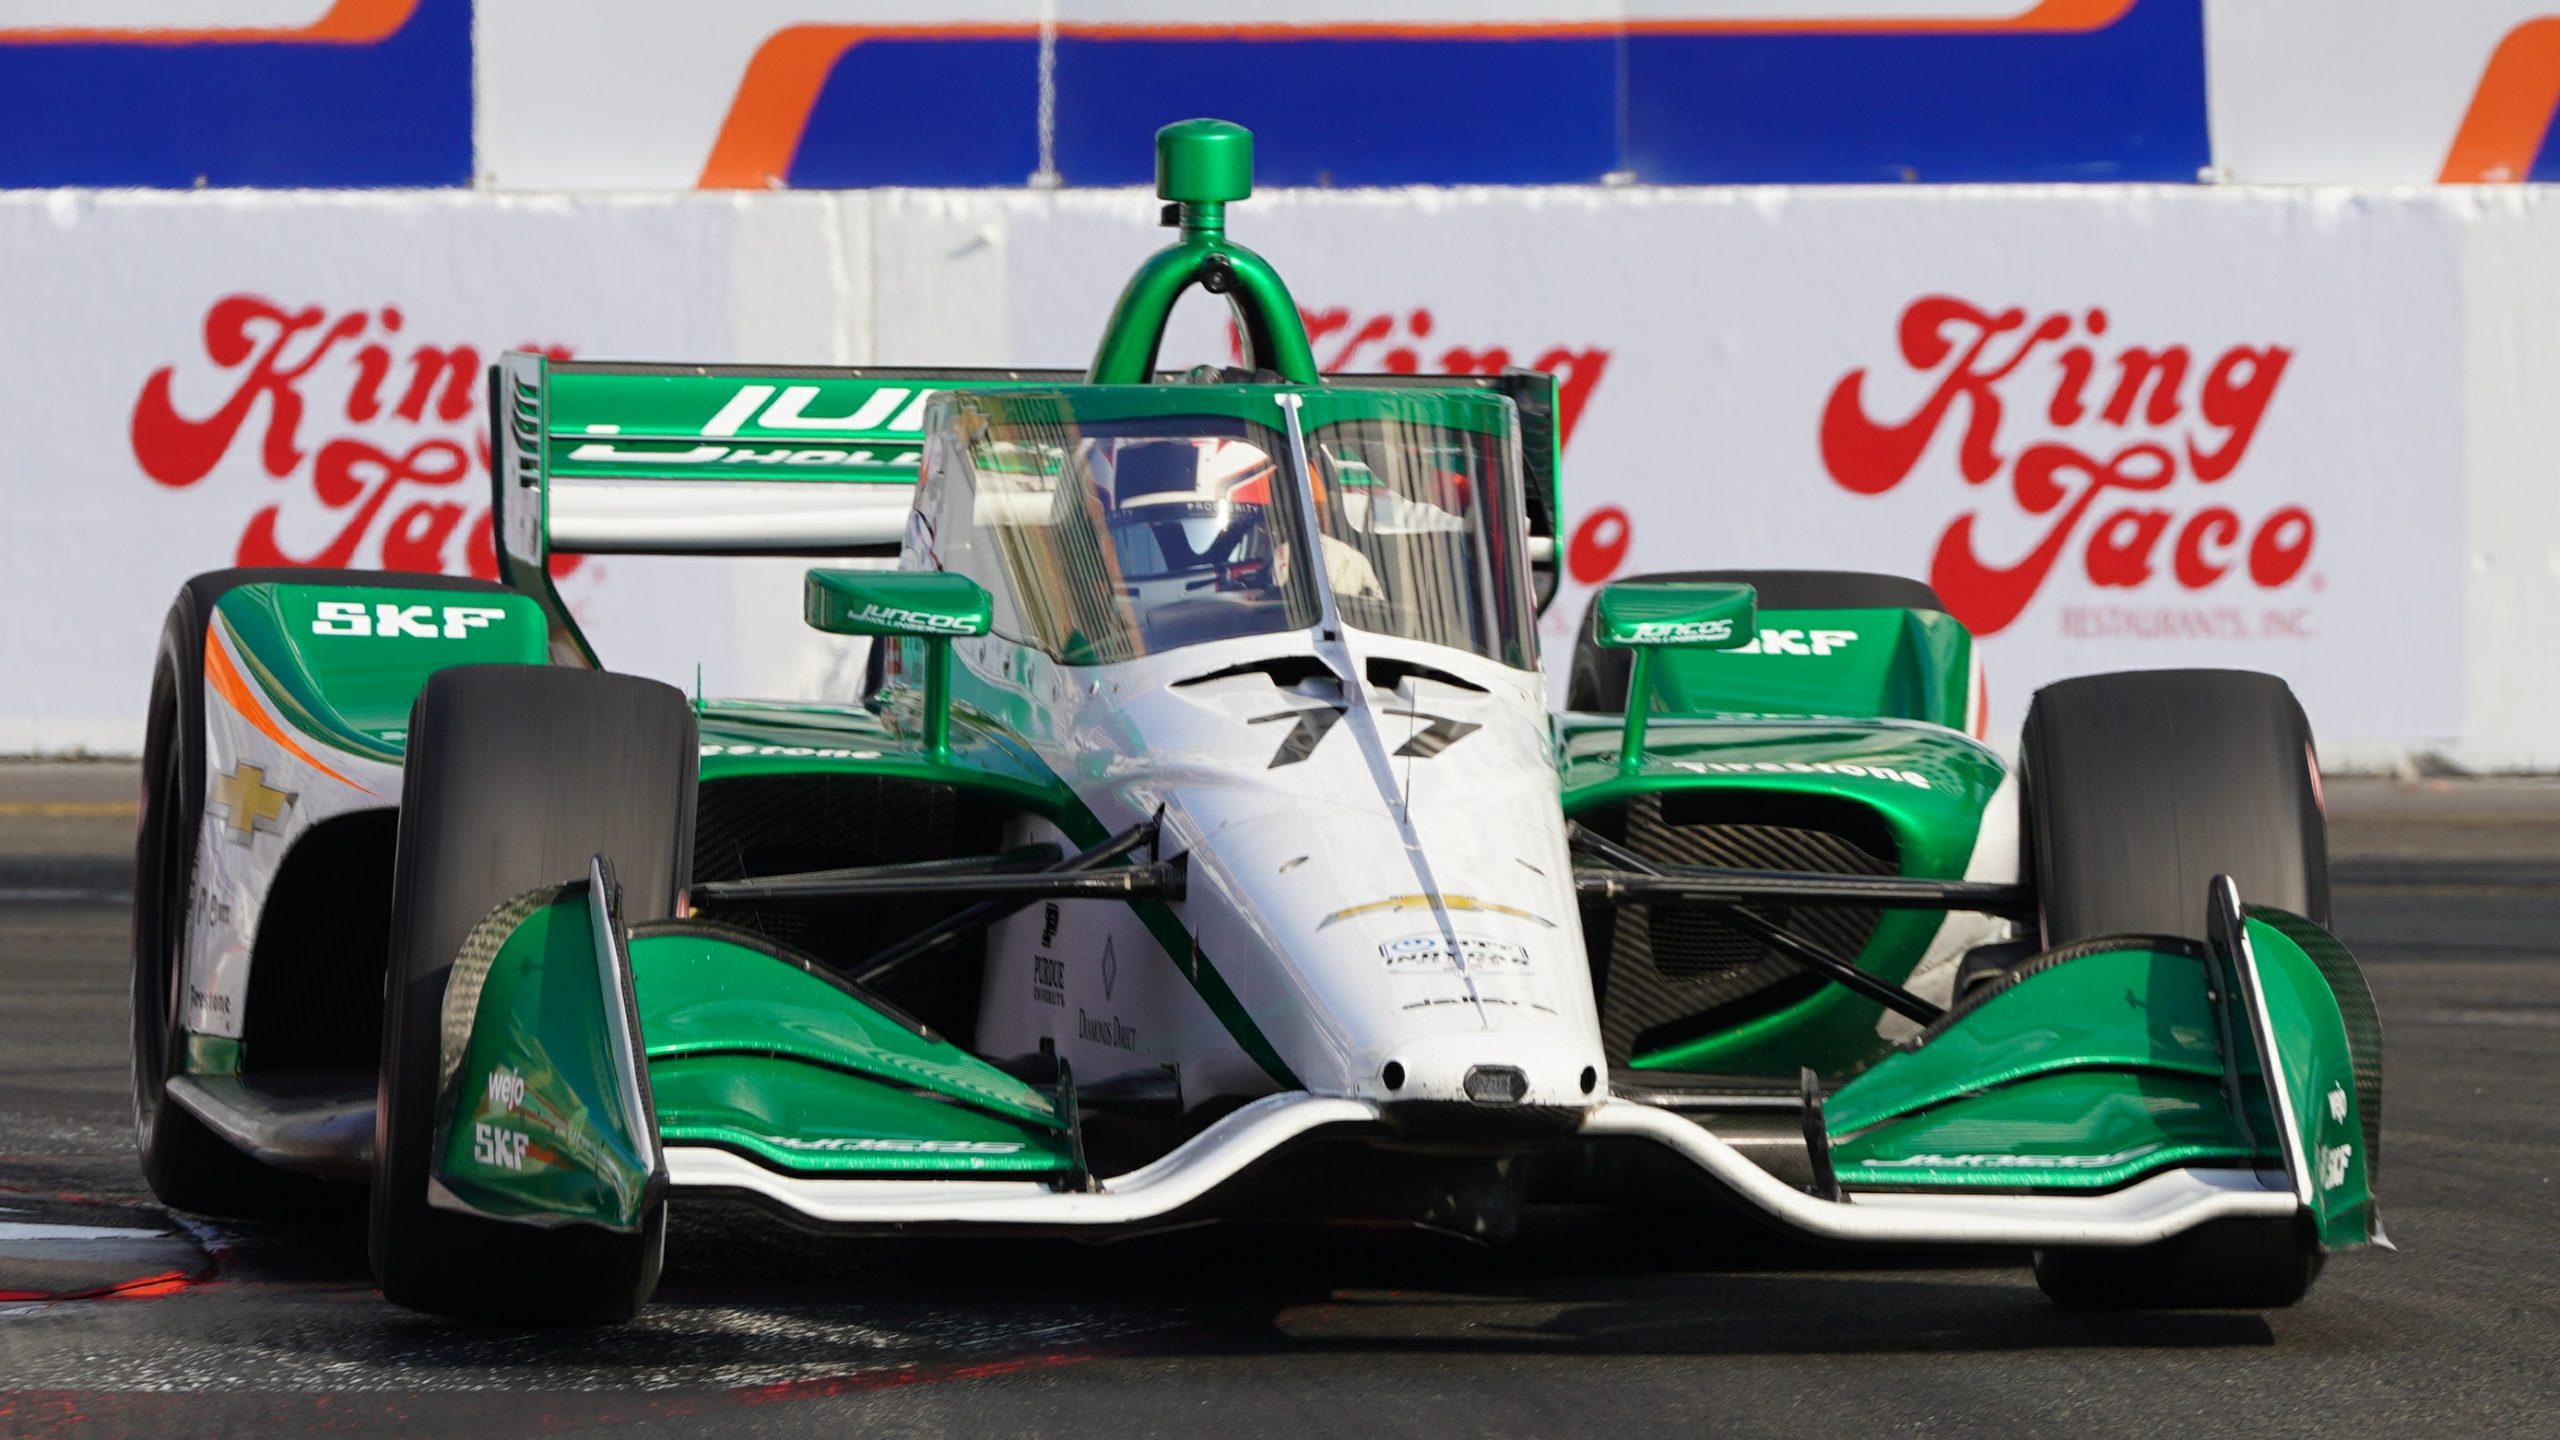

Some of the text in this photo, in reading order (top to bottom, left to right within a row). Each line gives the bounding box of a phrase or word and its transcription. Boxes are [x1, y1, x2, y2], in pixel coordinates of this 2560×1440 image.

[131, 293, 573, 490] Kin
[1819, 295, 2292, 495] King
[1930, 440, 2315, 635] Taco
[312, 602, 505, 637] SKF
[1671, 761, 1932, 789] Firestone
[489, 1067, 524, 1110] wejo
[474, 1123, 529, 1171] SKF
